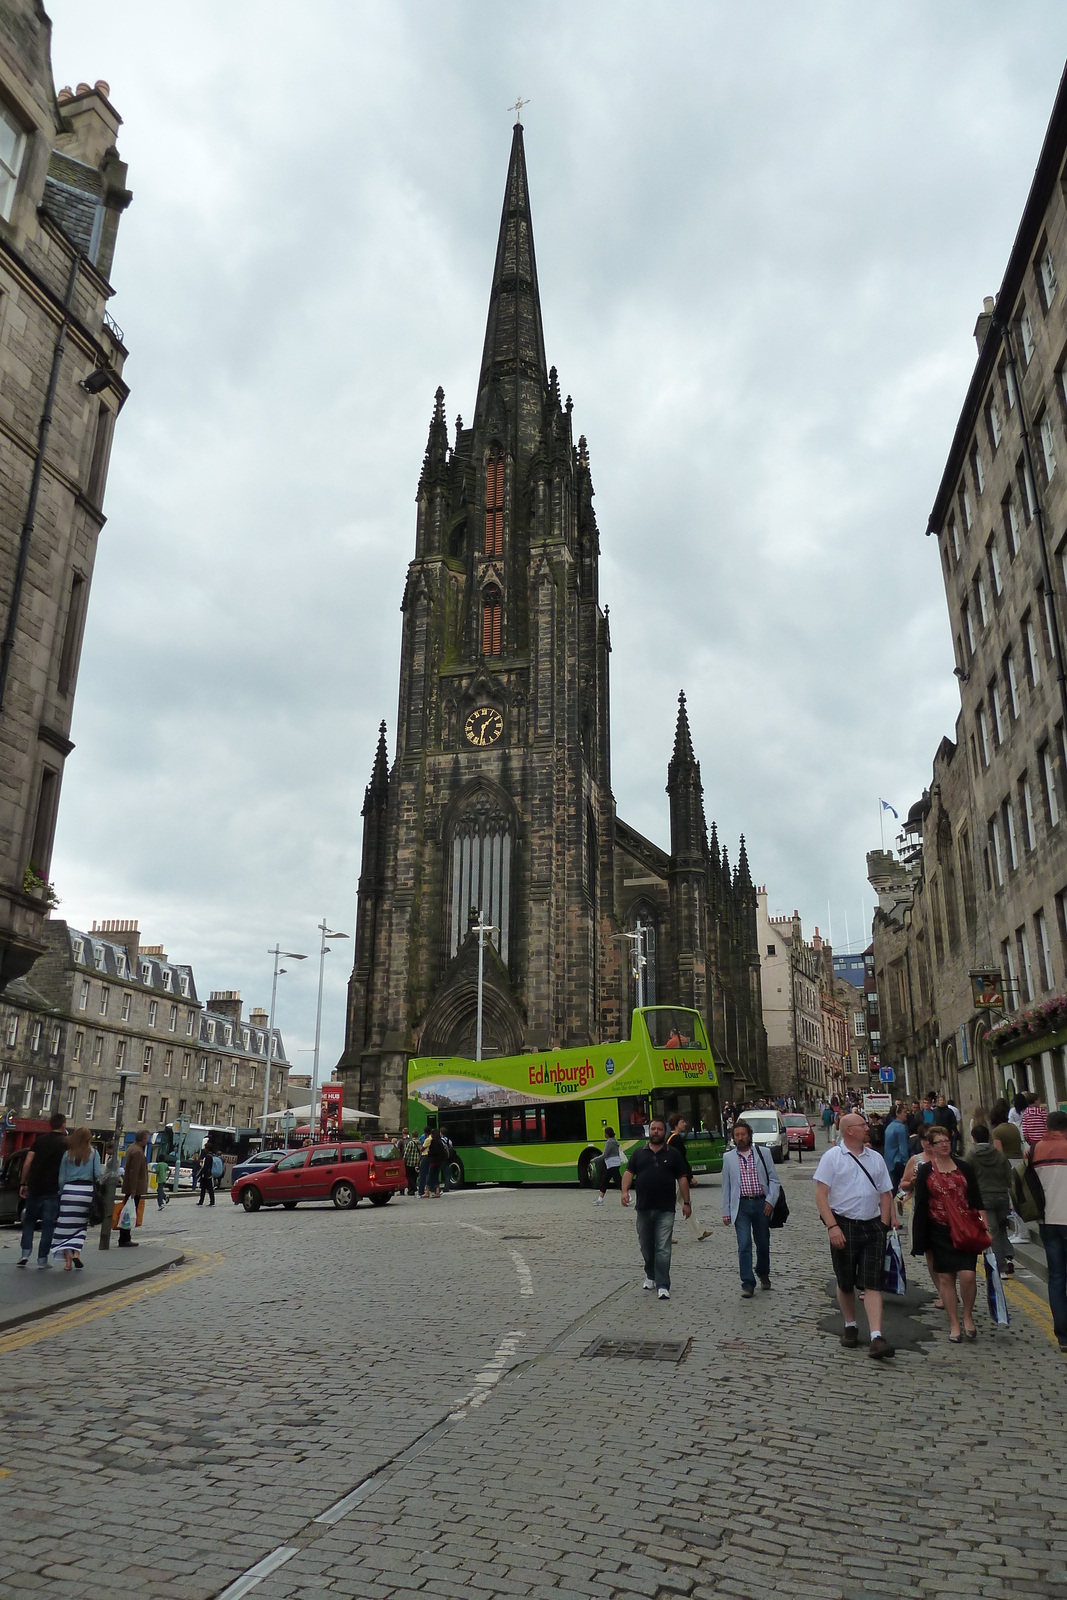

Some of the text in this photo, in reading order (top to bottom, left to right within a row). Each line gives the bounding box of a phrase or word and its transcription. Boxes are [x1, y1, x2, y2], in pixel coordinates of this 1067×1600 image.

[529, 1059, 594, 1086] Edinburgh
[663, 1056, 707, 1075] Edinburgh
[683, 1070, 700, 1078] Tour
[554, 1081, 579, 1094] Tour
